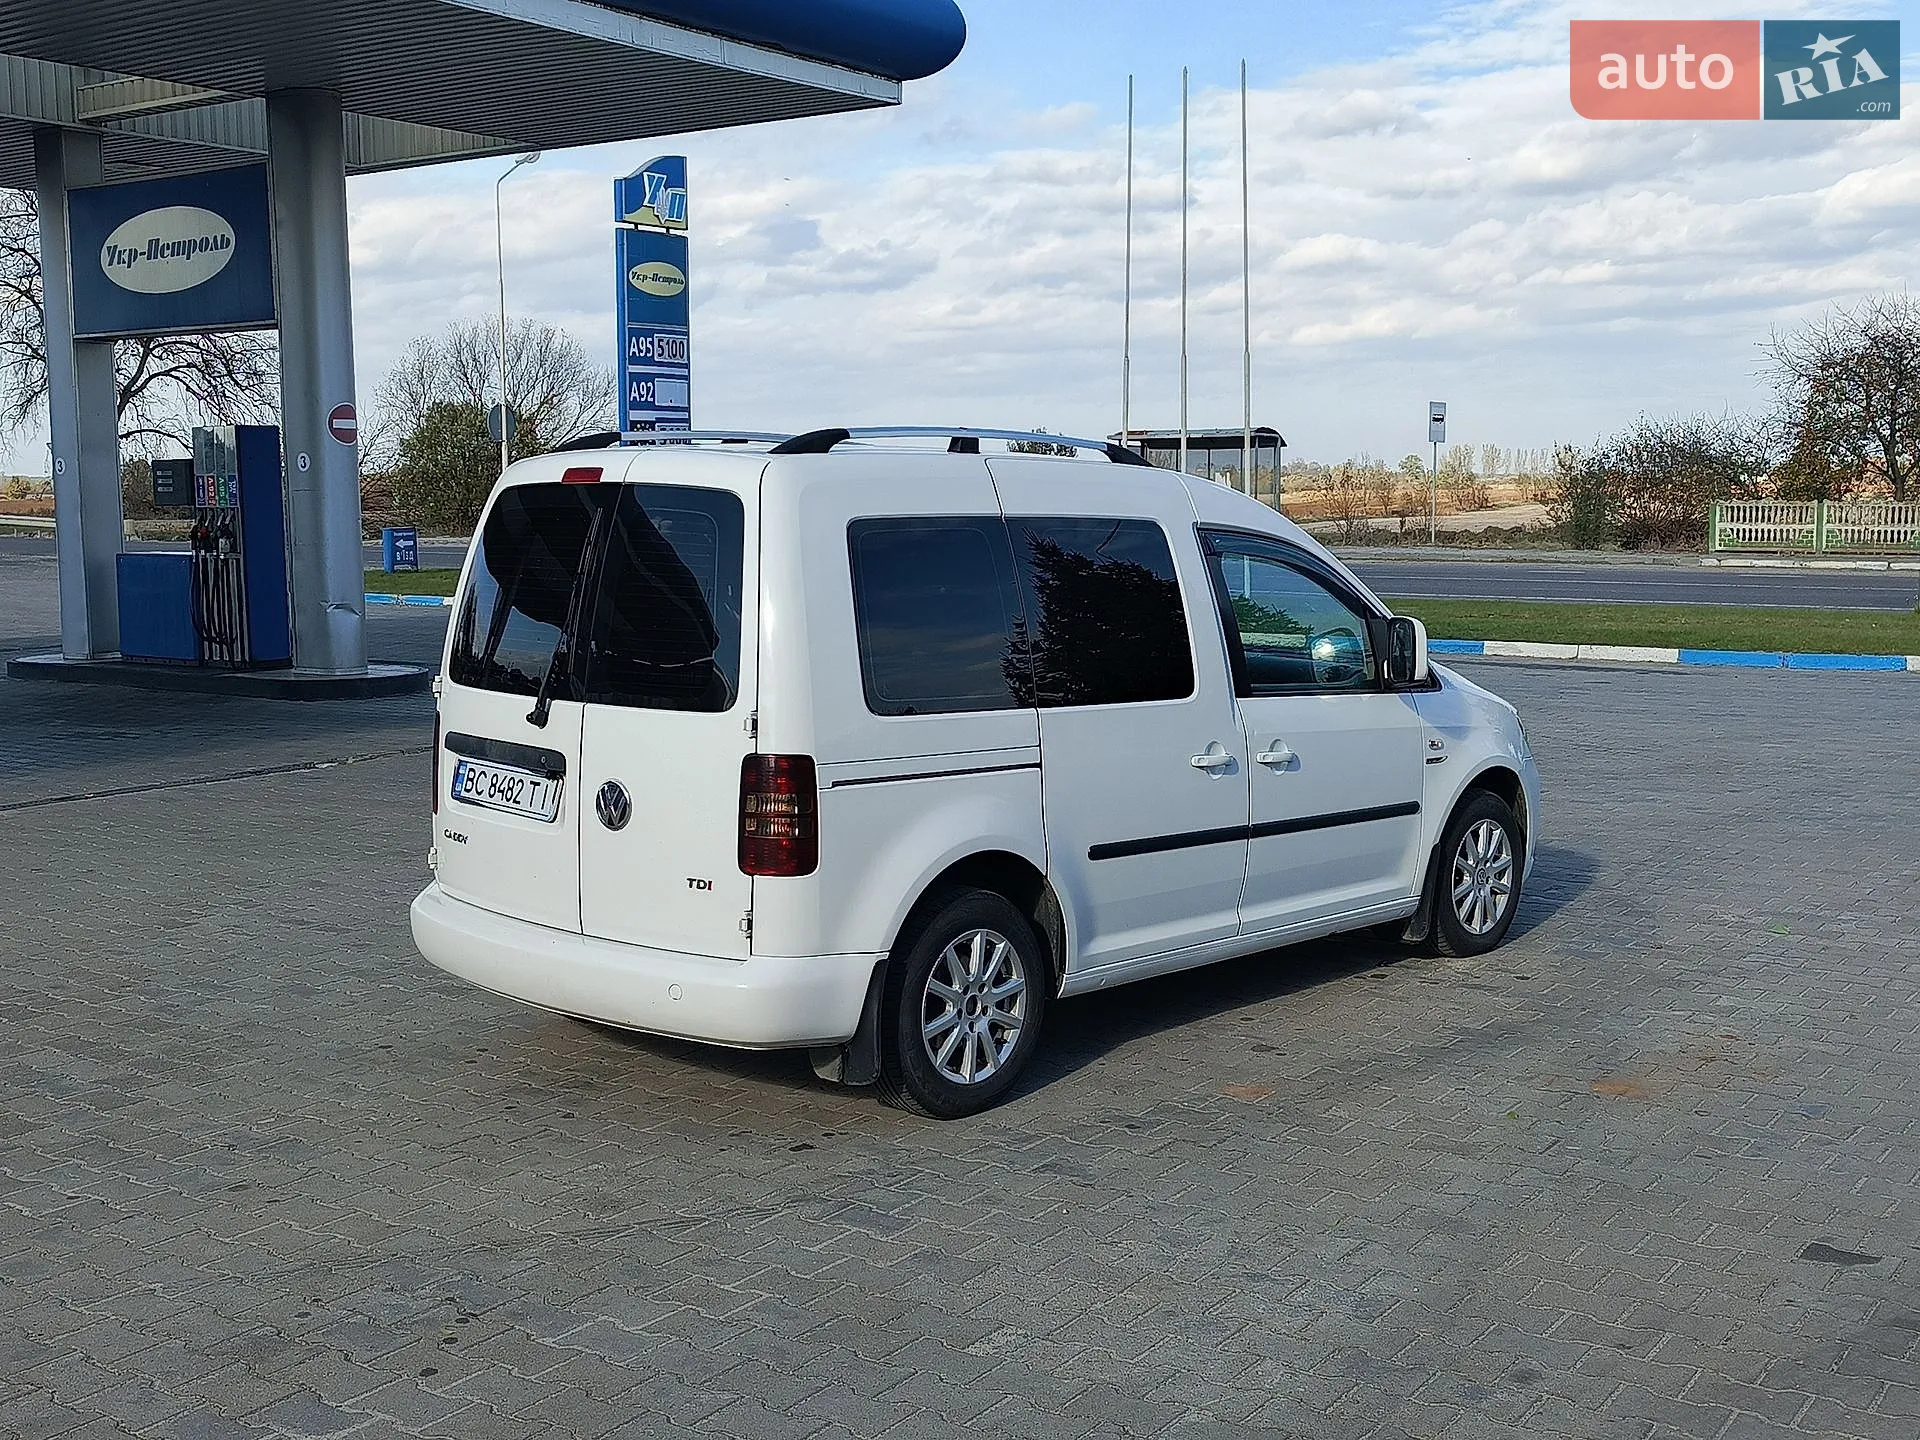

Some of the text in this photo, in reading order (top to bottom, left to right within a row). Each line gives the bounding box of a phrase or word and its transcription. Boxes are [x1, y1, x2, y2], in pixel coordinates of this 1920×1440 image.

[105, 233, 232, 270] Укр-Петроль
[57, 460, 63, 473] 3
[300, 455, 307, 469] 3
[463, 767, 488, 796] BC
[487, 773, 525, 805] 8482
